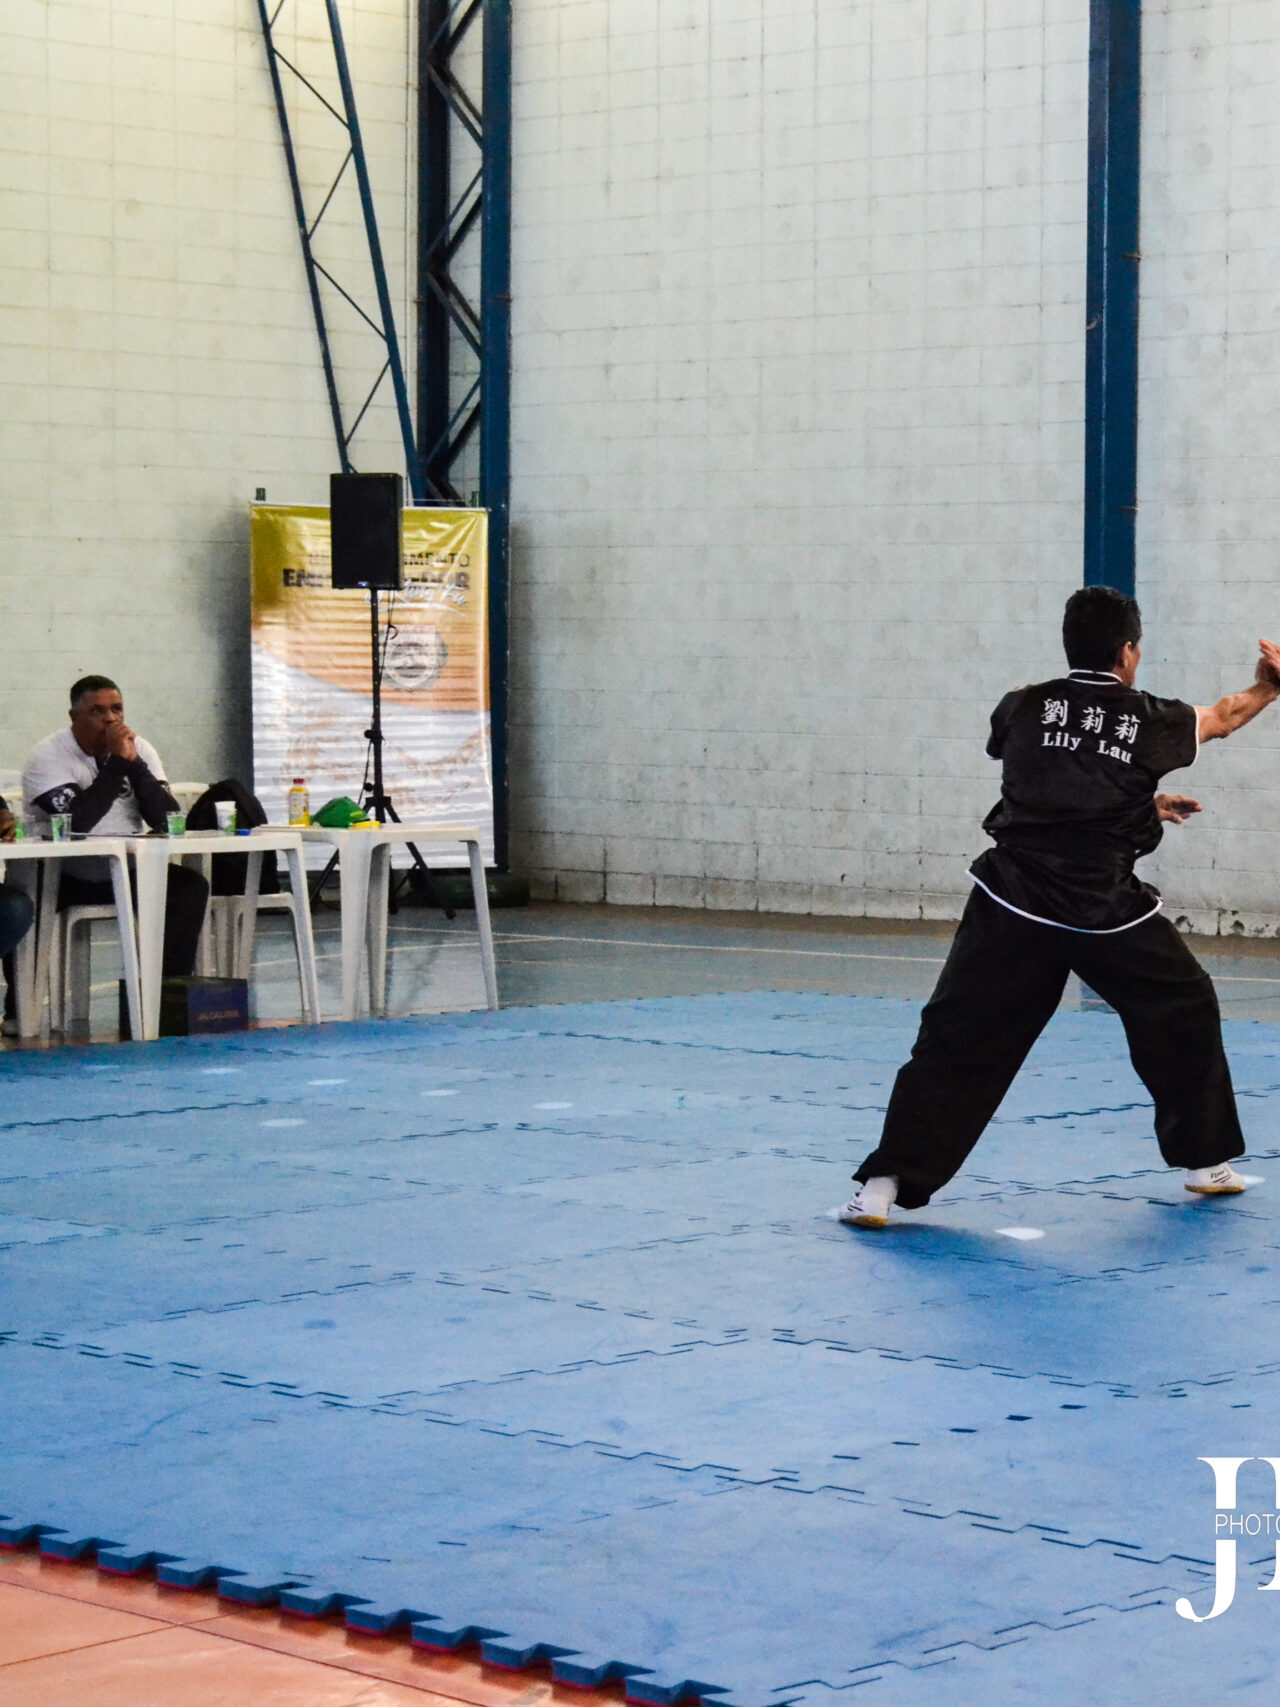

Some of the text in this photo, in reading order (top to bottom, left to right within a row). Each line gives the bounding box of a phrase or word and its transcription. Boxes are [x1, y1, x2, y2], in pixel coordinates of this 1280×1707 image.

[1040, 698, 1142, 744] 劉莉莉
[1041, 731, 1133, 764] Lily Lau
